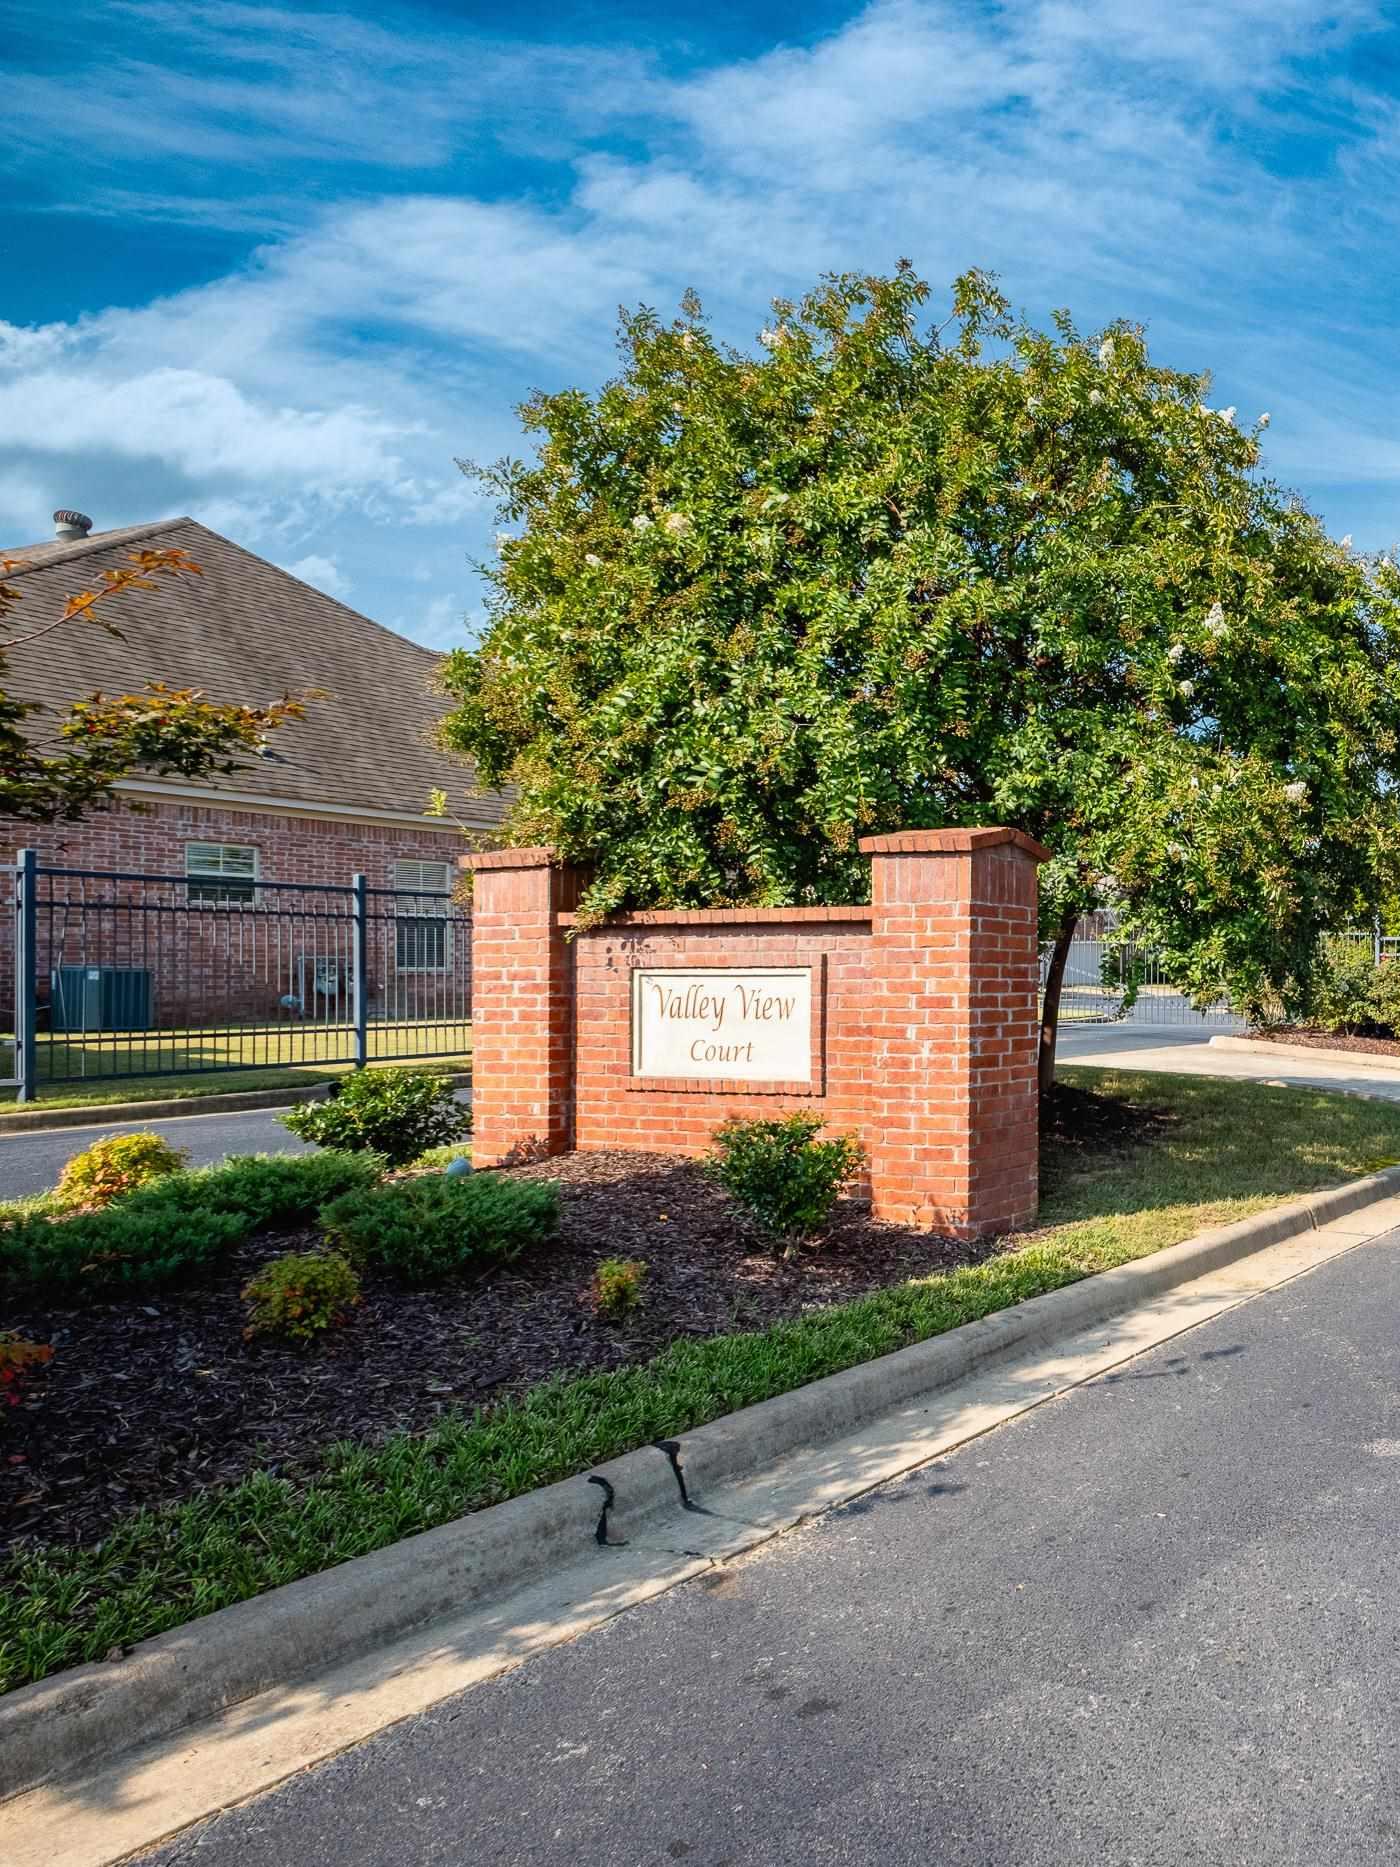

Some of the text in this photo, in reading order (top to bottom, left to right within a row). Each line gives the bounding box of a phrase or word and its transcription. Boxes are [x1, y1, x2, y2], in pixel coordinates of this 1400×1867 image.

[653, 984, 796, 1032] Valley View
[690, 1039, 755, 1062] Court
